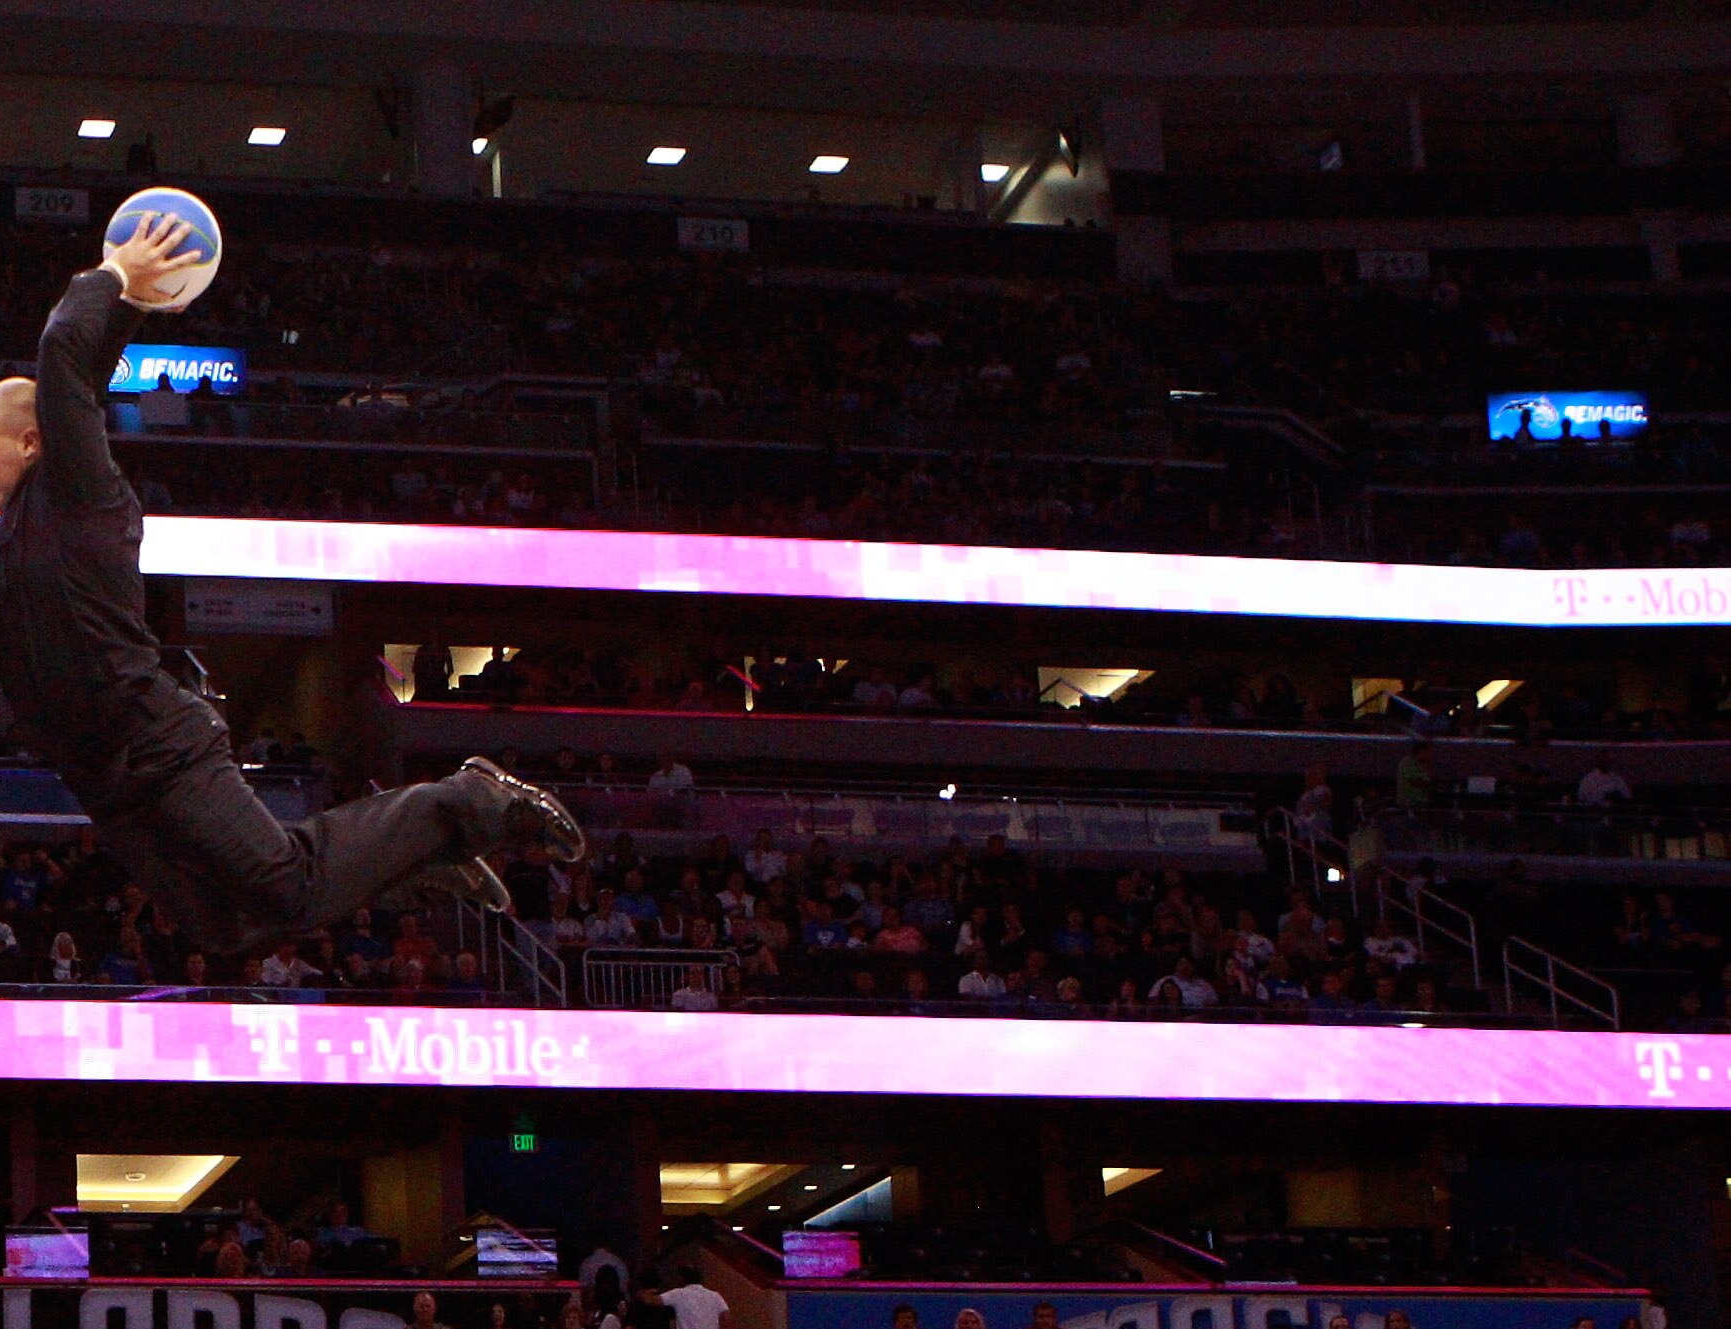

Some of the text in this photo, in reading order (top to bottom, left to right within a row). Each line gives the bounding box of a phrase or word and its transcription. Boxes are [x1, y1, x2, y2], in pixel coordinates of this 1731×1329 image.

[30, 193, 75, 213] 209
[692, 225, 734, 243] 210
[513, 1134, 534, 1151] EXIT
